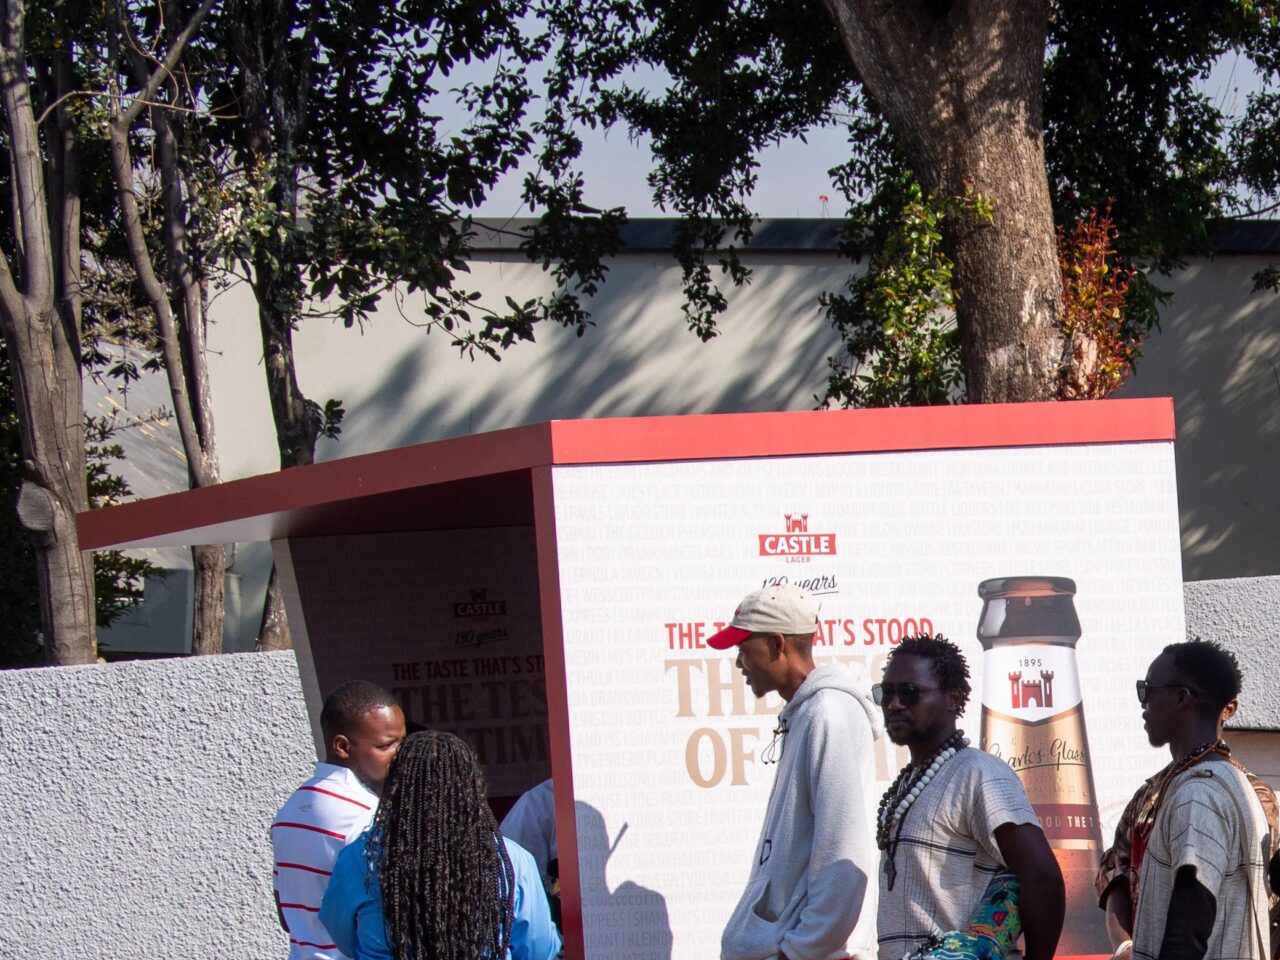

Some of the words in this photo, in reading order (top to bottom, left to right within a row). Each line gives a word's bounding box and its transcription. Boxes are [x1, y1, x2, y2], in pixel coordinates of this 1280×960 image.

[764, 536, 831, 554] CASTLE
[786, 556, 811, 565] LAGER
[457, 603, 502, 615] CASTLE
[476, 628, 510, 647] years
[665, 622, 706, 650] THE
[392, 663, 421, 681] THE
[427, 660, 469, 679] TASTE
[472, 657, 521, 676] THAT'S
[1018, 658, 1043, 668] 1895
[393, 682, 475, 724] THE
[685, 727, 760, 789] OF
[1067, 815, 1087, 828] THE
